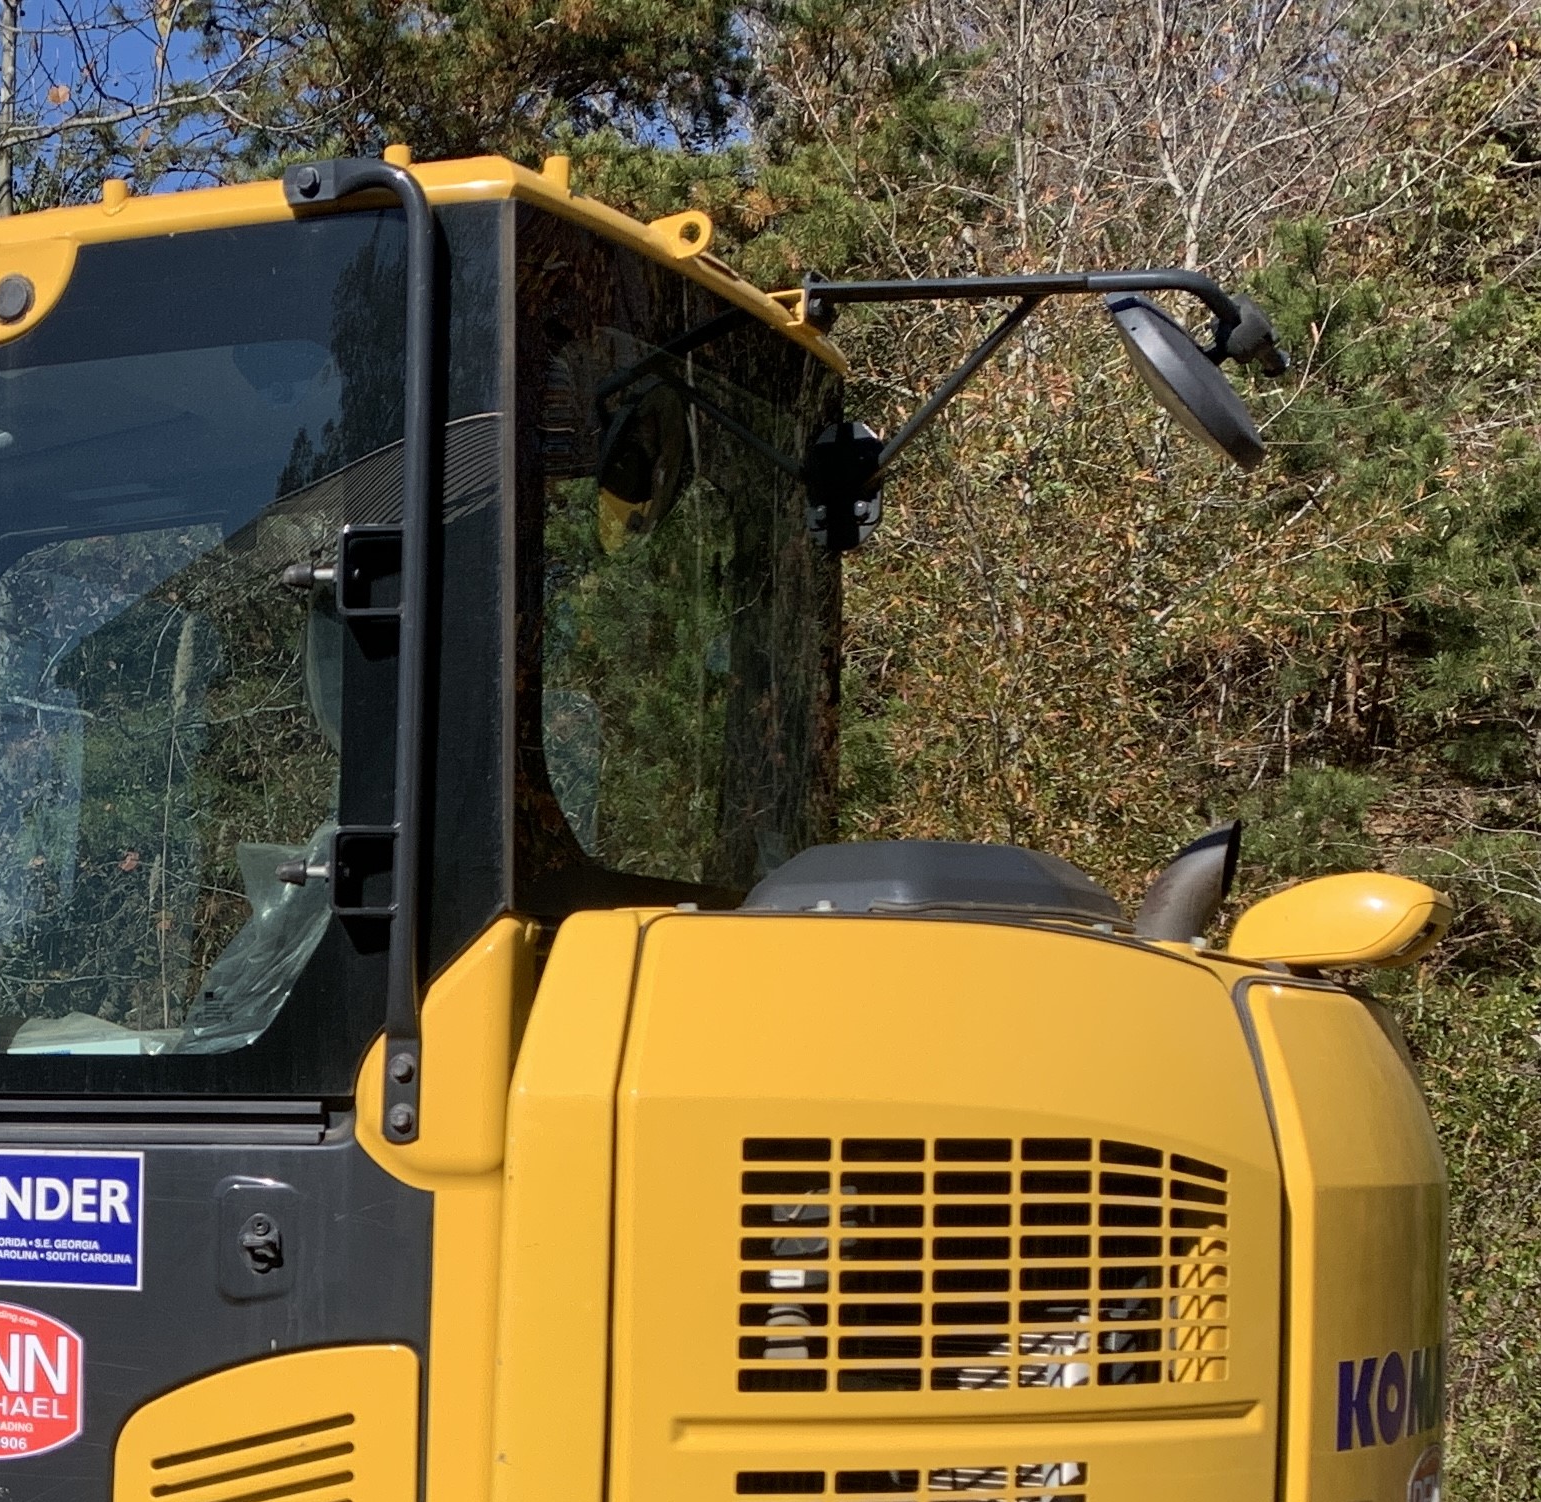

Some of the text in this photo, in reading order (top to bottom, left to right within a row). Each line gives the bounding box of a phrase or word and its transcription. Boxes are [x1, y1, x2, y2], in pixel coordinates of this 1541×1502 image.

[34, 1238, 52, 1248] S.E.
[54, 1239, 100, 1250] GEORGIA
[46, 1251, 79, 1262] SOUTH
[81, 1252, 133, 1264] CAROLINA
